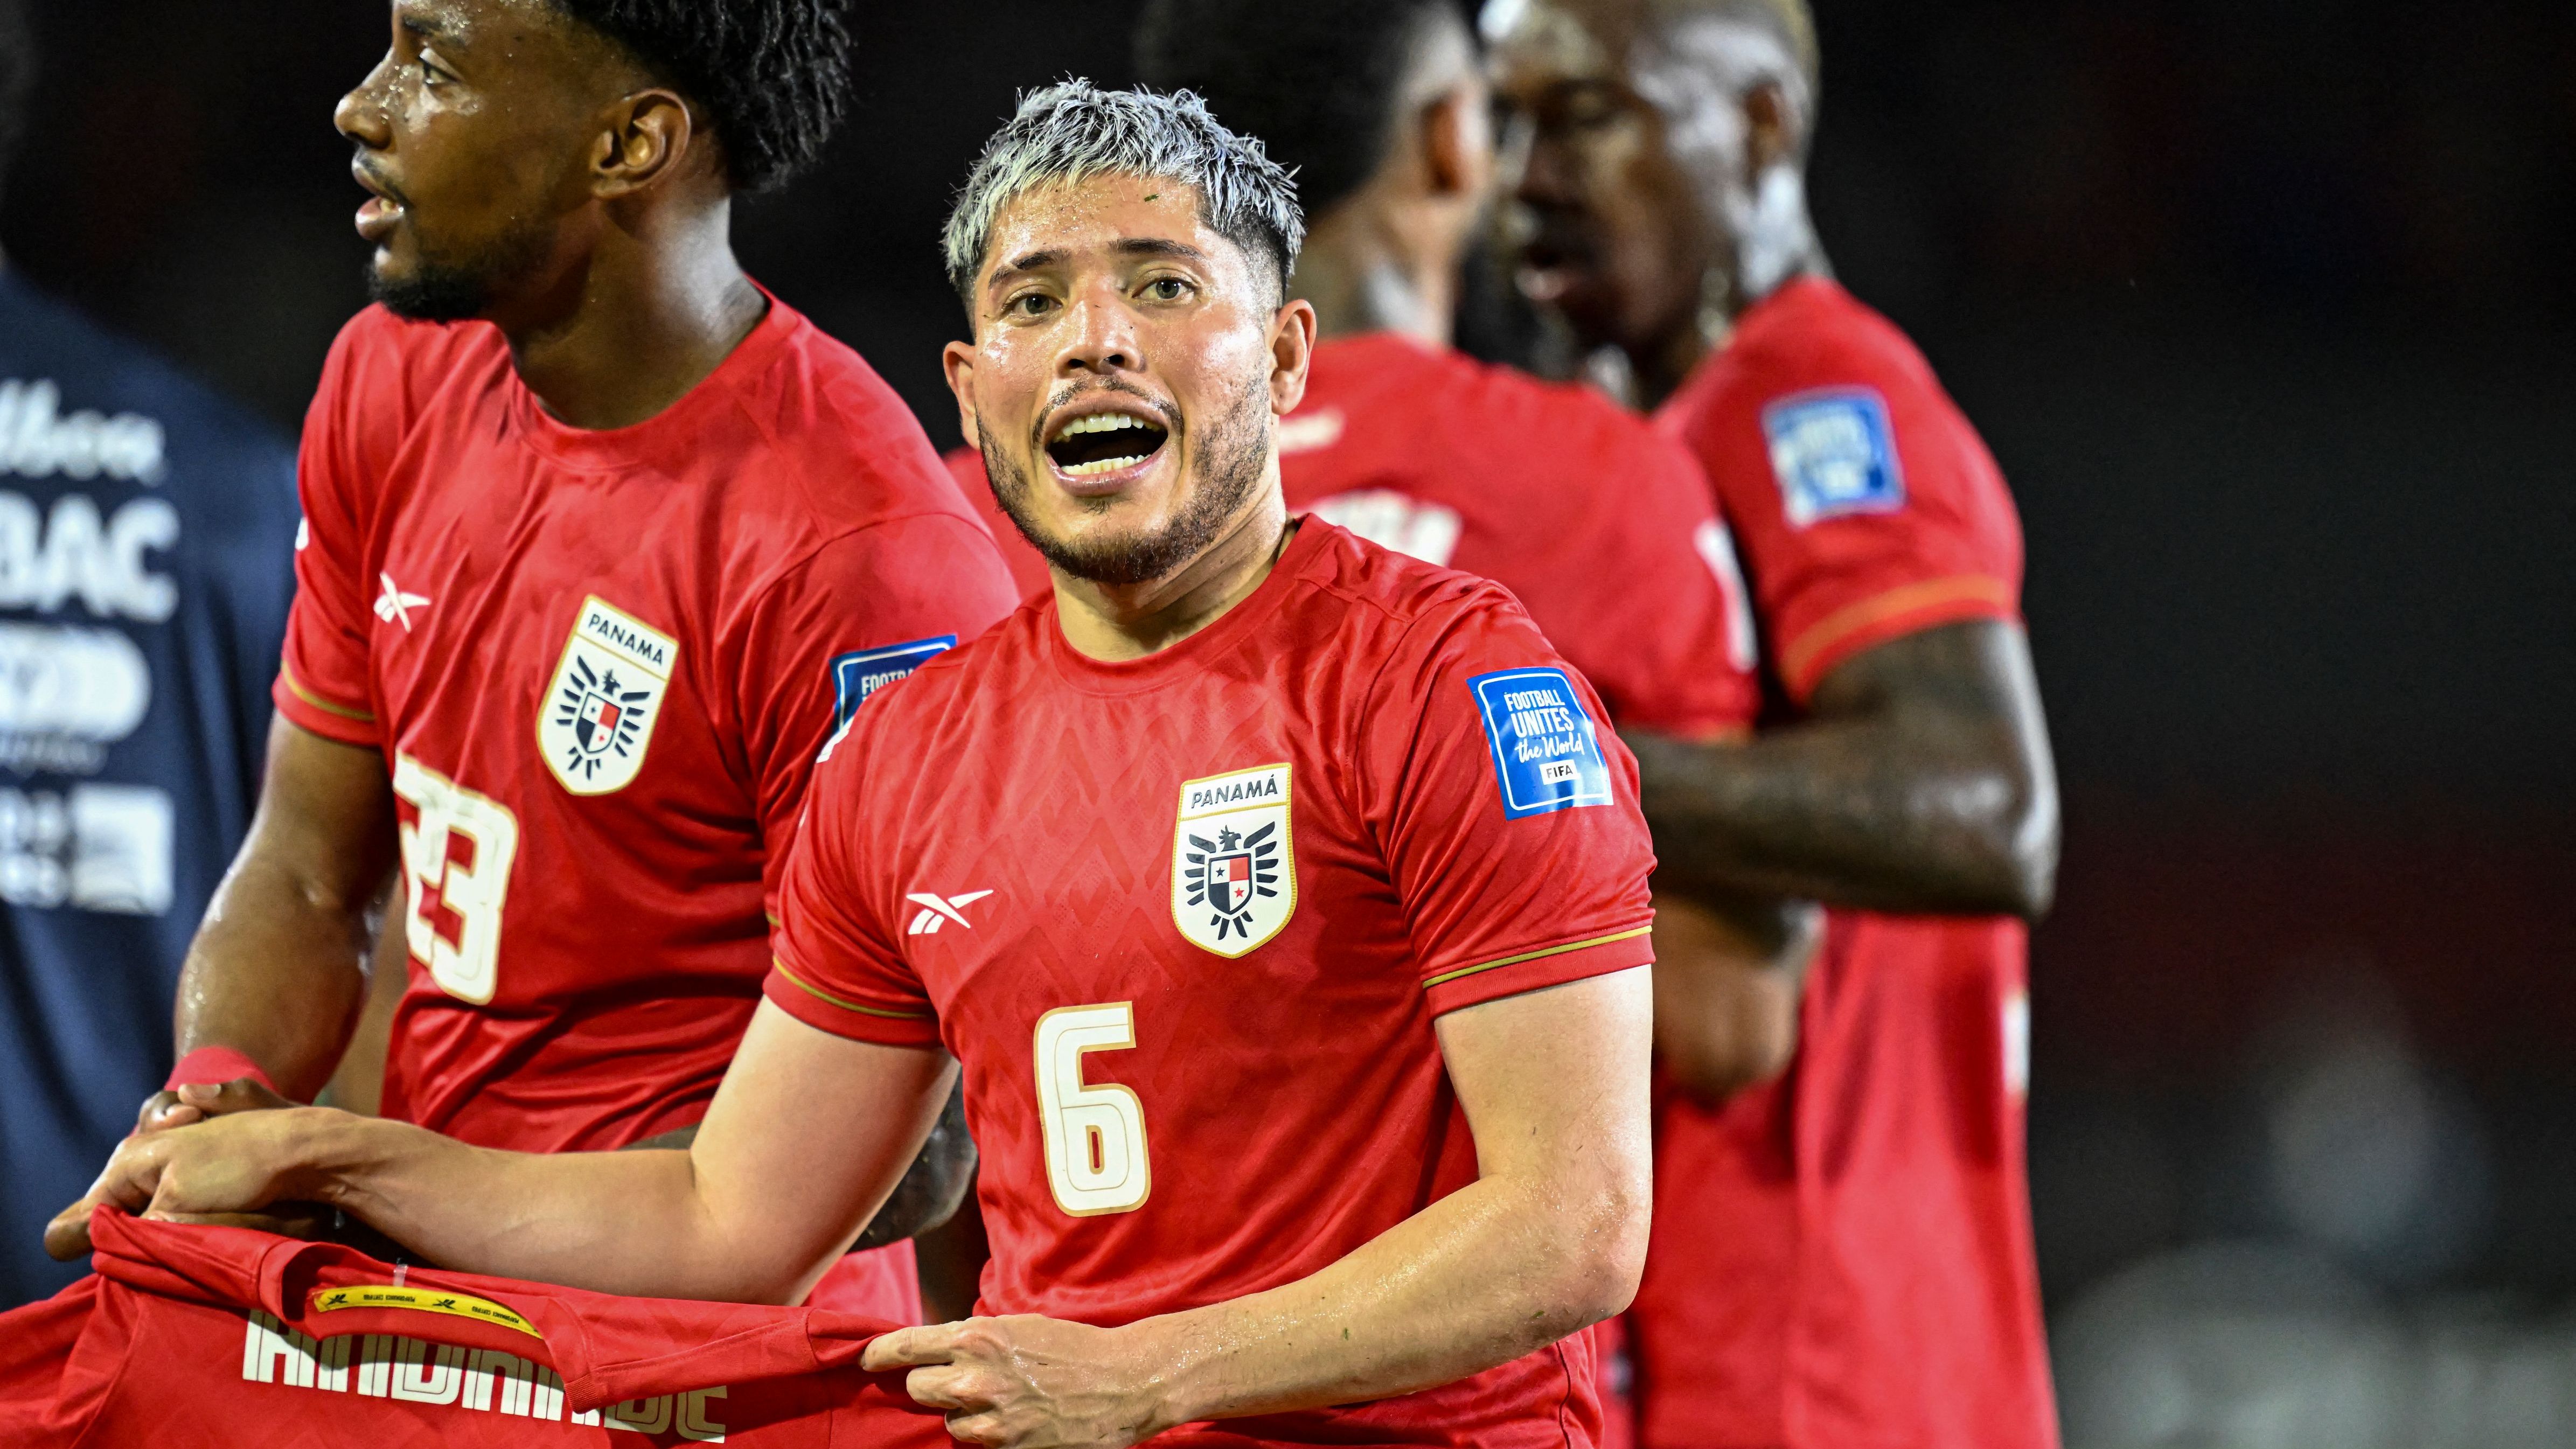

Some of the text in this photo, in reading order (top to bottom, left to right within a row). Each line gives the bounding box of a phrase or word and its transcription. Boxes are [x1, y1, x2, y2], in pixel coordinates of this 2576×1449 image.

[588, 614, 663, 666] PANAMÁ
[1504, 689, 1565, 712] FOOTBALL
[1510, 707, 1574, 737] UNITES
[1514, 732, 1585, 763] the World
[1546, 764, 1574, 779] FIFA
[1191, 774, 1278, 809] PANAMÁ
[1034, 1001, 1151, 1217] 6
